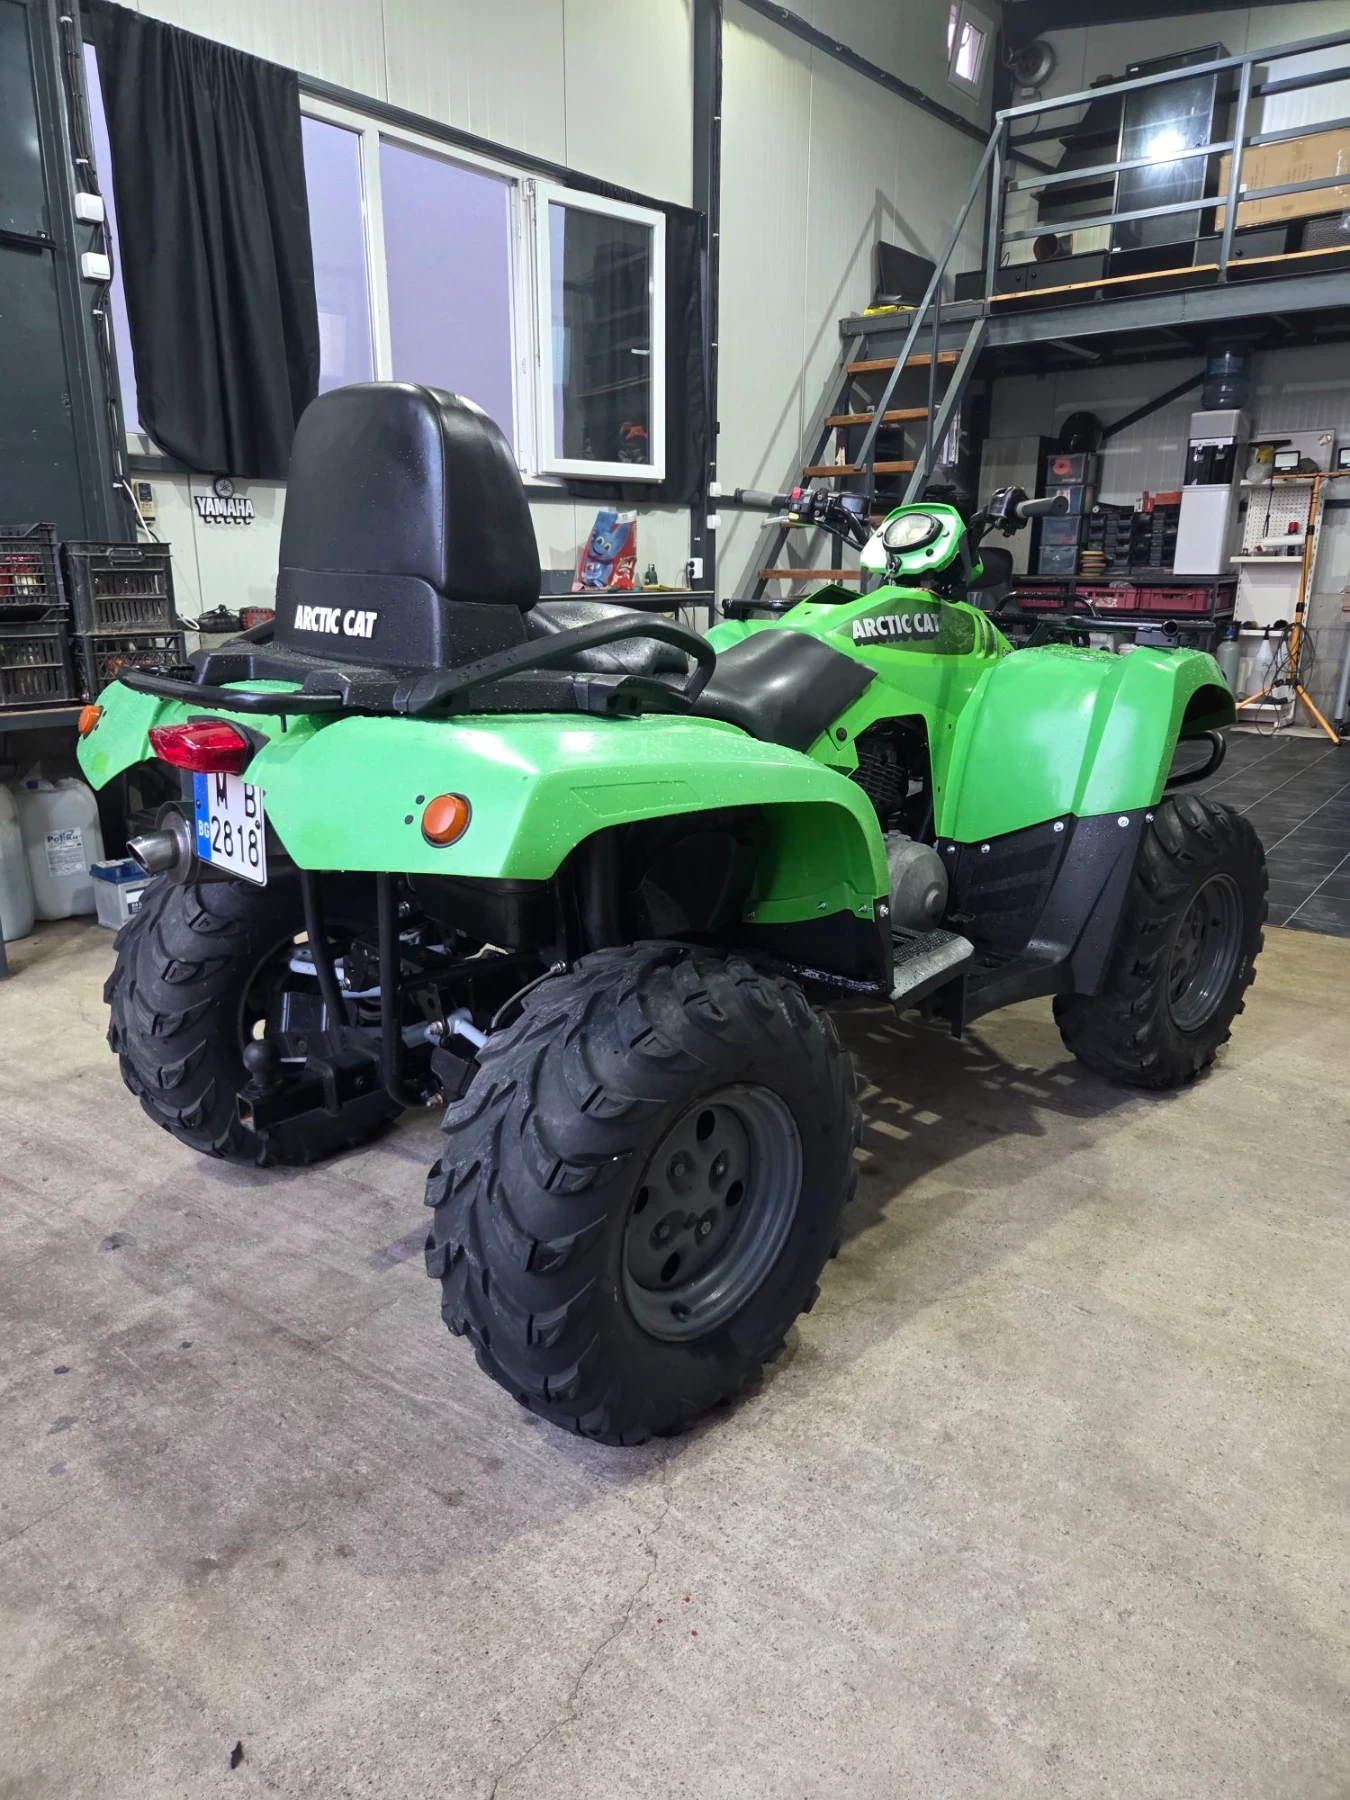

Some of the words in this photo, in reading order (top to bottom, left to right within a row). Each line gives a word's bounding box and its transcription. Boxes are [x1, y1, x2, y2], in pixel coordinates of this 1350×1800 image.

[196, 496, 255, 517] YAMAHA
[294, 605, 341, 634] ARCTIC
[343, 609, 378, 638] CAT
[852, 613, 912, 640] ARCTIC
[913, 613, 940, 633] CAT
[199, 820, 210, 838] BG
[211, 816, 259, 867] 2818
